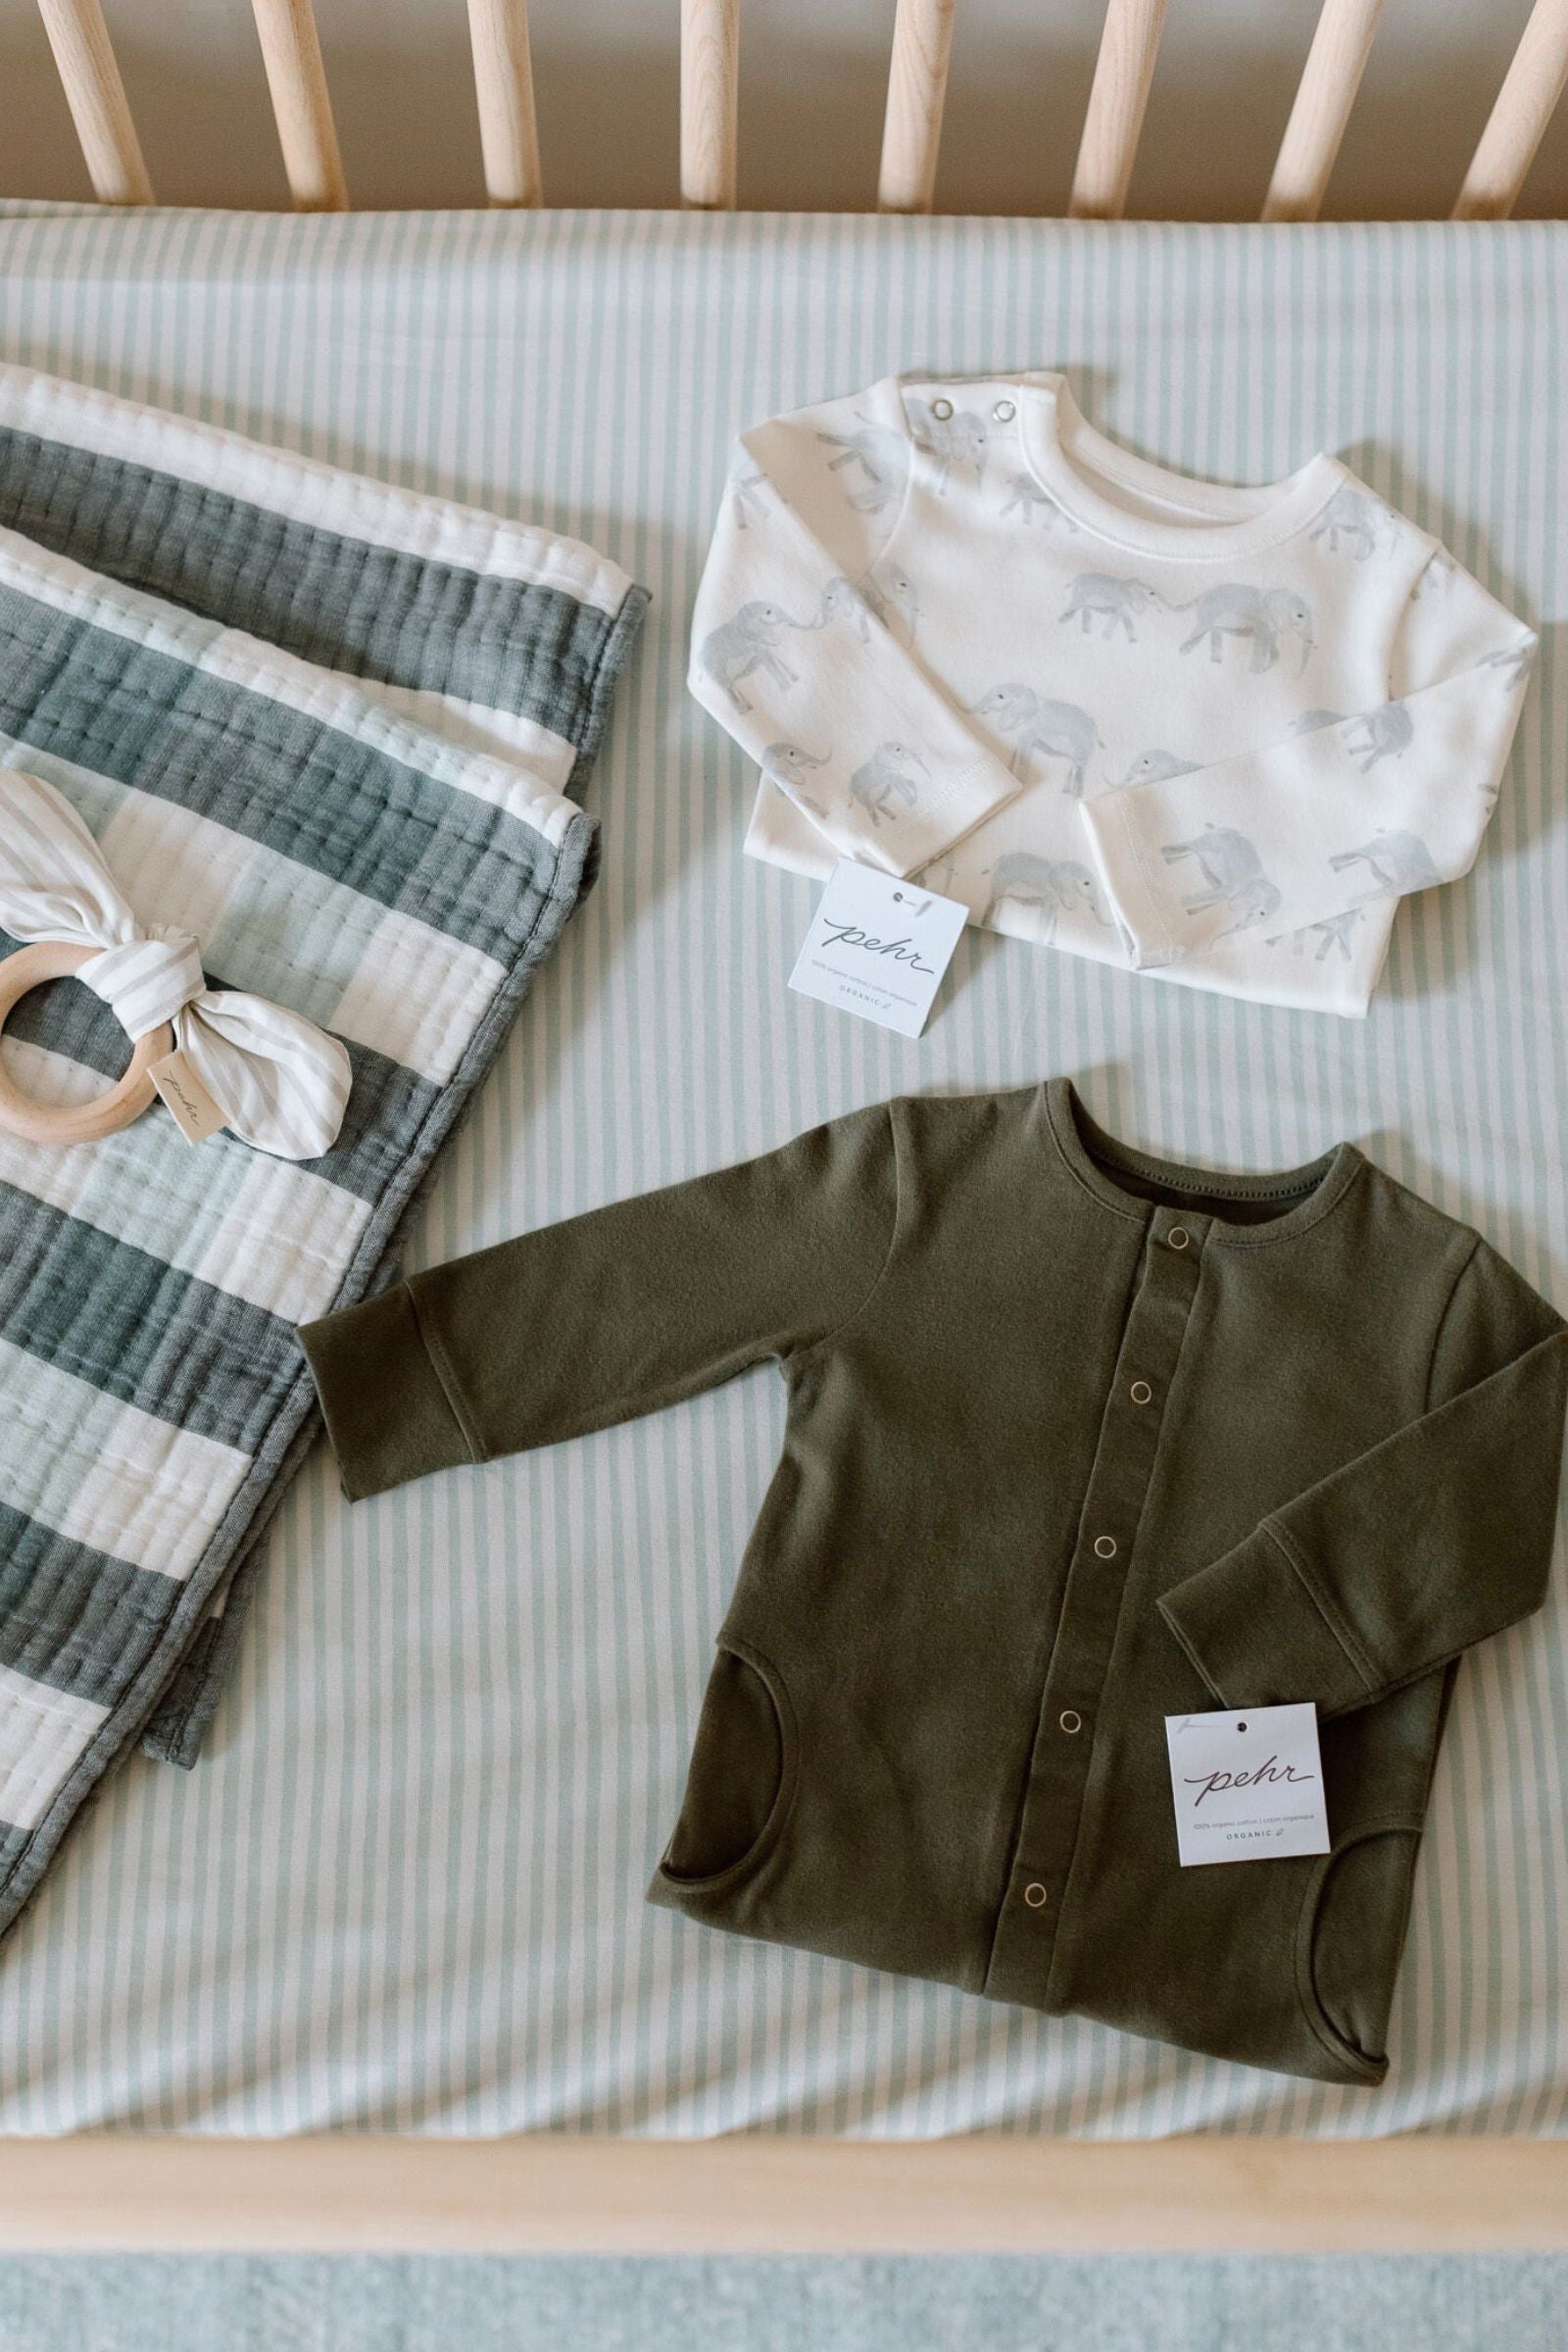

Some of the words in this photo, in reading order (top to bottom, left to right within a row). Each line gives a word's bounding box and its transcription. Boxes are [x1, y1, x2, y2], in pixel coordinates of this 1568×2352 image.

[820, 917, 935, 974] pehr
[1184, 1754, 1315, 1807] pehr
[1226, 1830, 1272, 1840] ORGANIC
